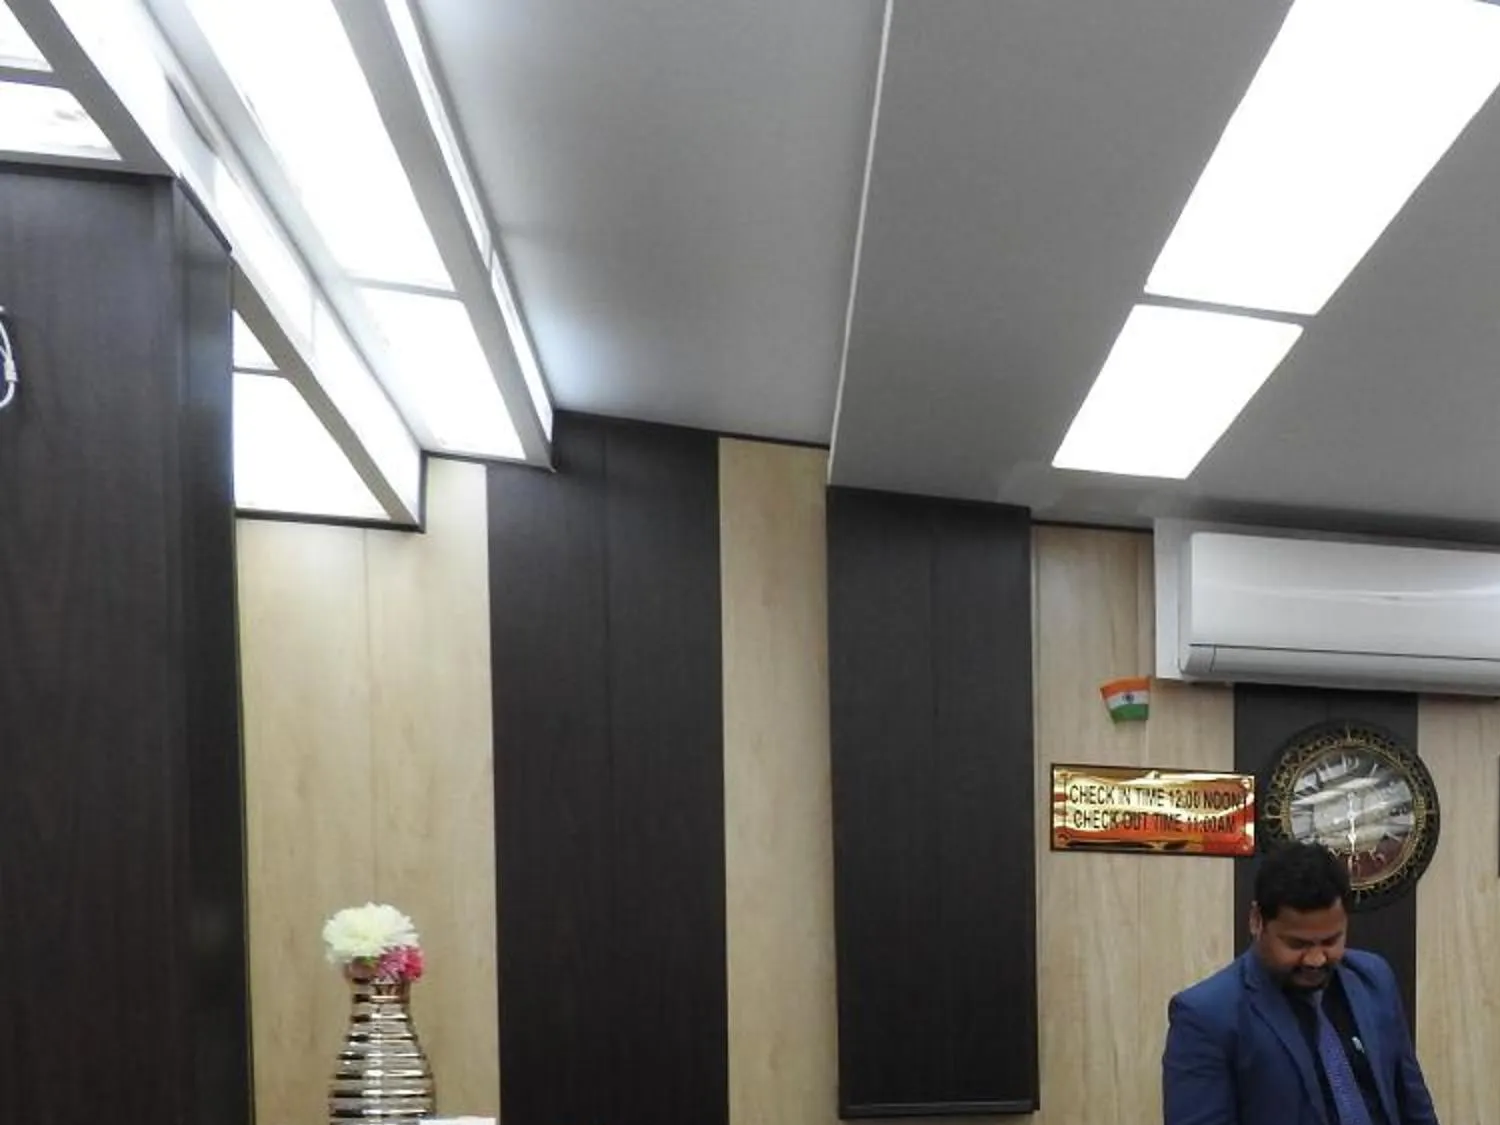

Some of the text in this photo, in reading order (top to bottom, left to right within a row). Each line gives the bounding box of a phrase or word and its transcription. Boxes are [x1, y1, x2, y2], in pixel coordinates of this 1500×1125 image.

[1070, 785, 1115, 805] CHECK
[1118, 786, 1132, 806] IN
[1135, 787, 1165, 807] TIME
[1203, 791, 1240, 810] NOON
[1074, 809, 1120, 829] CHECK
[1122, 811, 1149, 831] OUT
[1152, 812, 1183, 832] TIME
